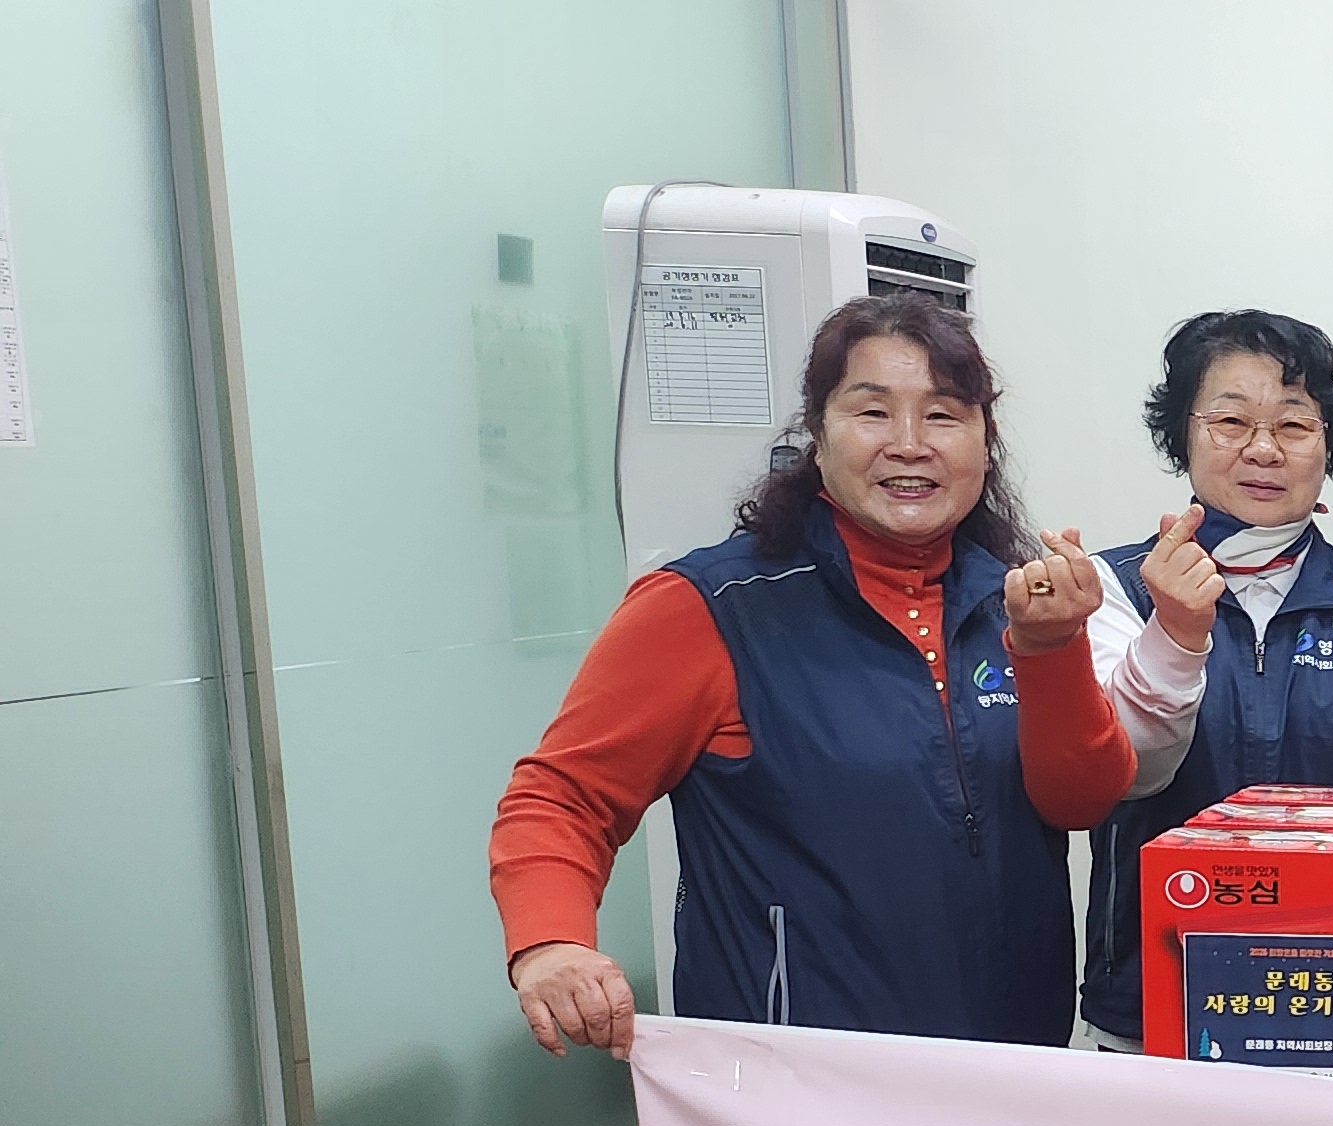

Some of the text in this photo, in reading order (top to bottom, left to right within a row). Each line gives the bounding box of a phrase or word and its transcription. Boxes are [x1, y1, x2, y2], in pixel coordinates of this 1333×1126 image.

[1211, 878, 1280, 905] 농심
[1266, 972, 1333, 991] 문래동
[1204, 995, 1274, 1014] 사랑의
[1246, 1040, 1274, 1050] 문래동
